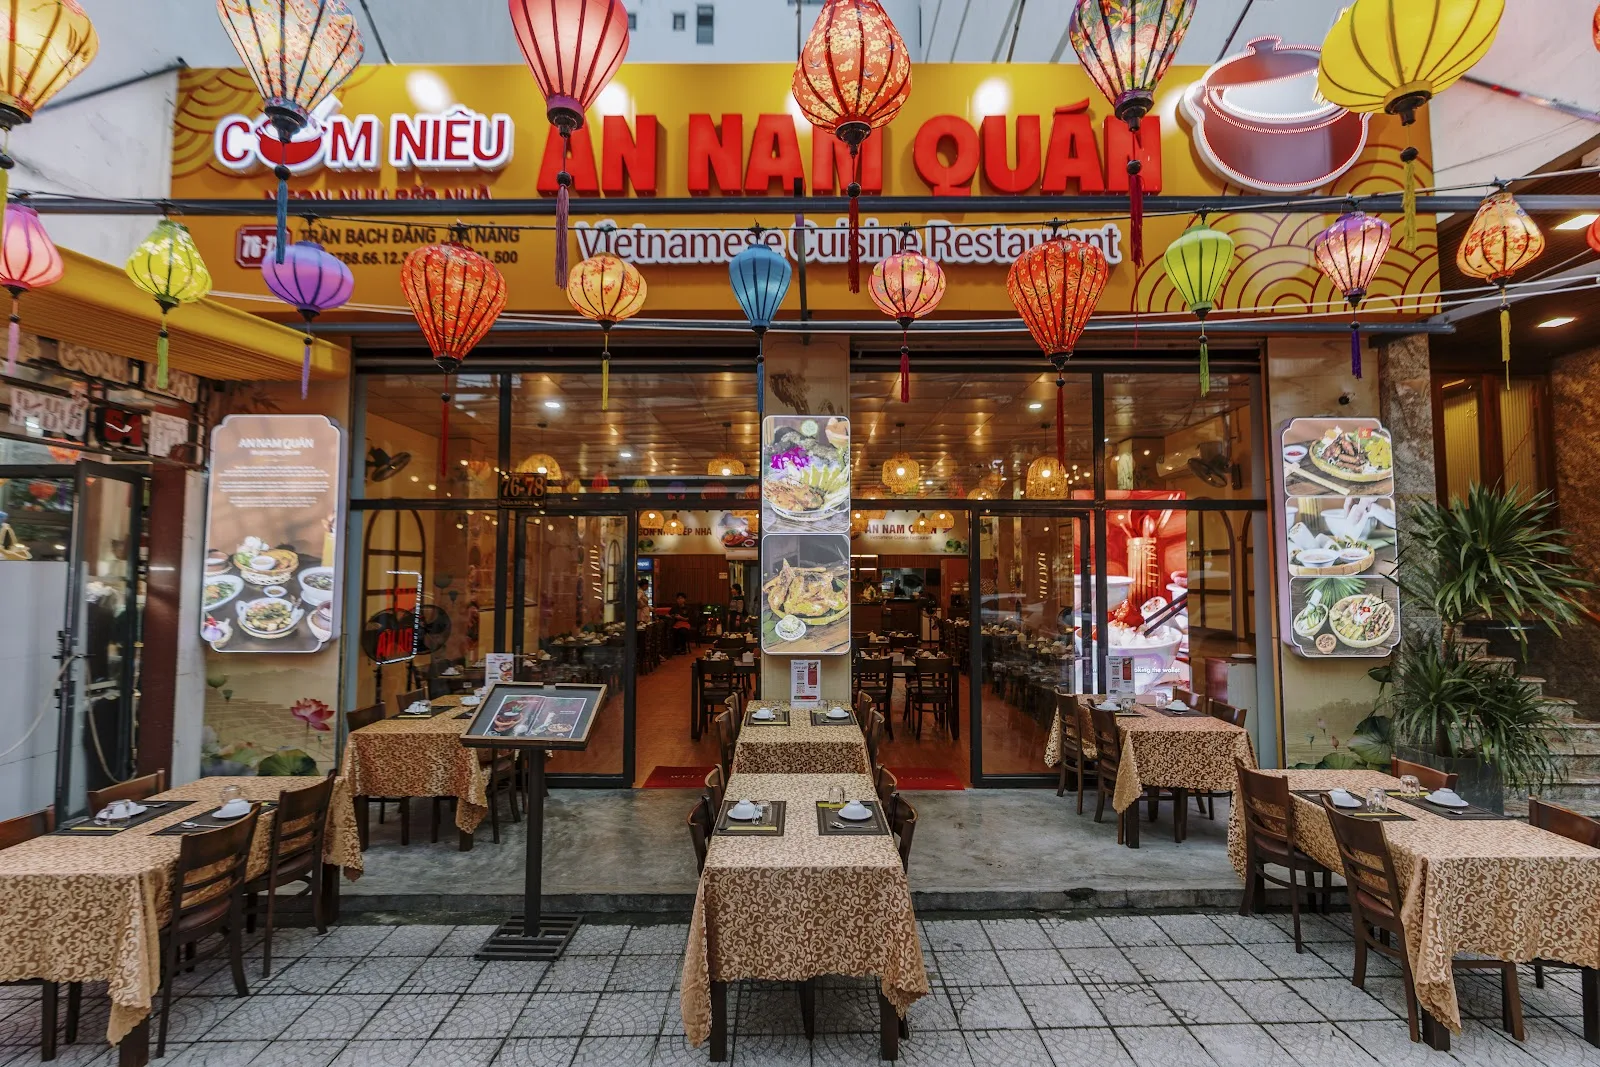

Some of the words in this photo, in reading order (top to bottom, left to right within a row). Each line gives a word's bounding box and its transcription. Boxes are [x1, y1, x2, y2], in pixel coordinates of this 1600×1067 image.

[389, 104, 514, 171] NIÊU
[688, 112, 883, 195] NAM
[913, 97, 1163, 196] QUÁN
[574, 220, 785, 264] Vietnamese
[789, 219, 921, 265] Cuisine
[926, 220, 1123, 265] Restaurant
[882, 524, 905, 534] NAM
